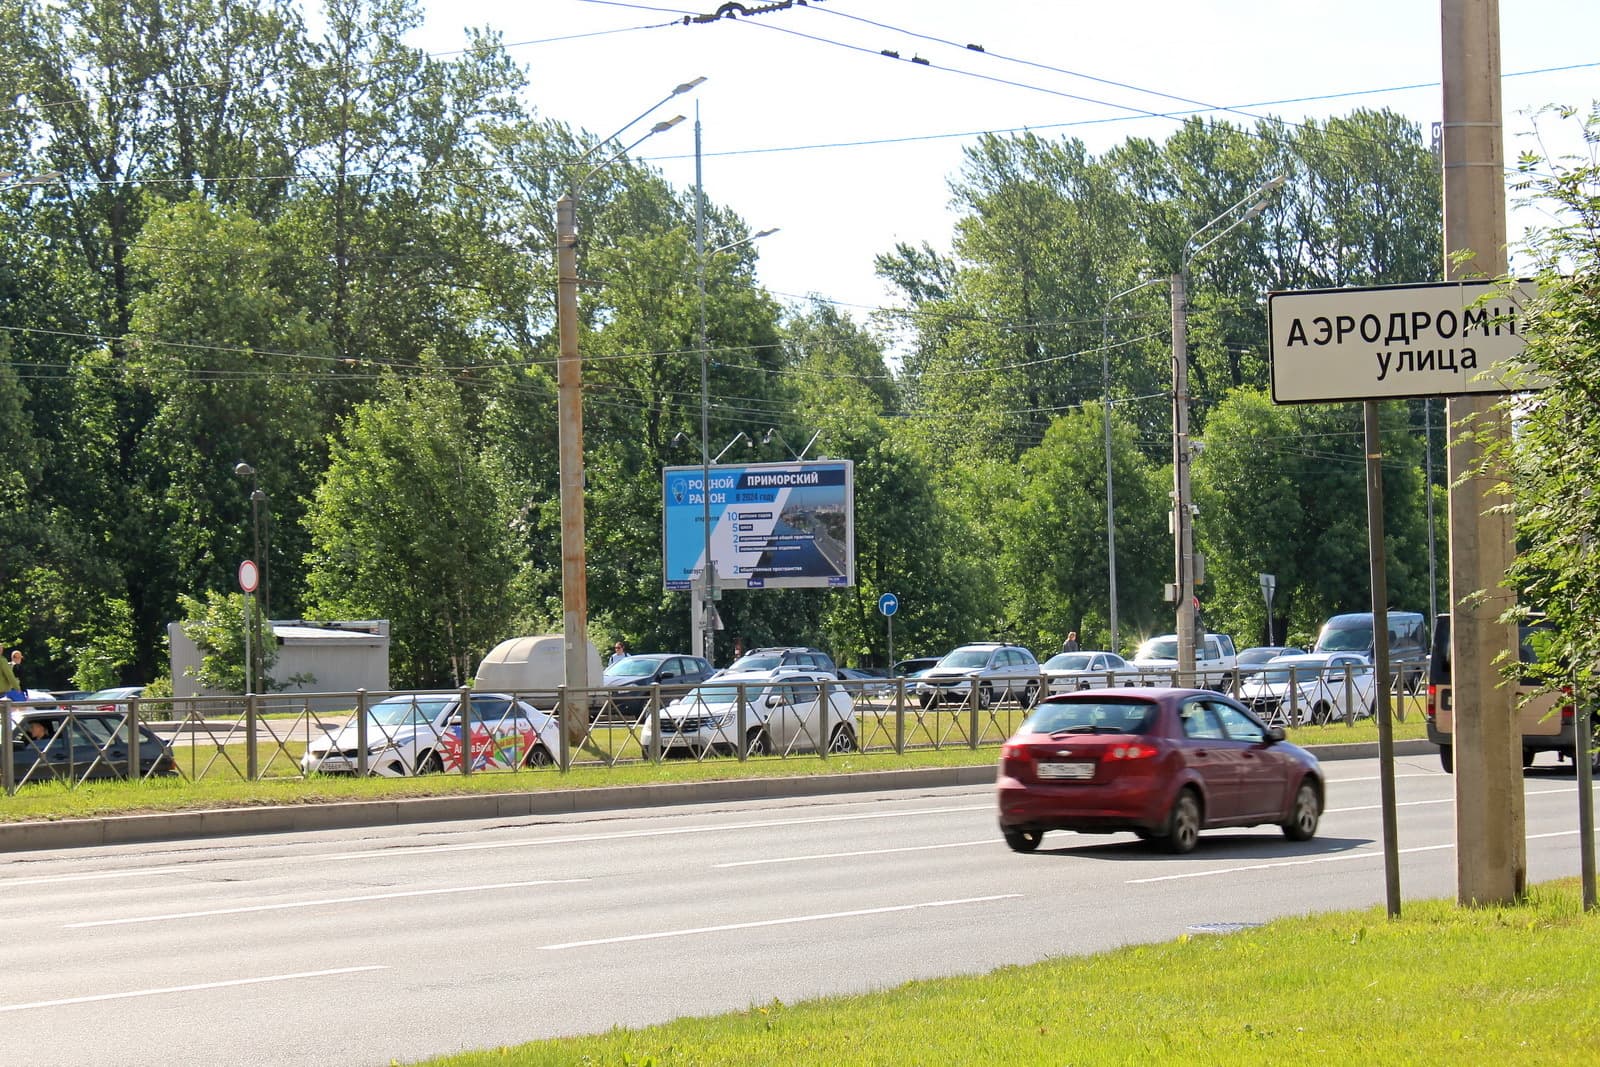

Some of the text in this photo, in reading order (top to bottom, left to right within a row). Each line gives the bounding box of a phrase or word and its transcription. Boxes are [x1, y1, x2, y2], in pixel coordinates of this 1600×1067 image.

[1287, 307, 1526, 347] АЭРОДРОМН
[1376, 347, 1477, 381] улица
[747, 471, 819, 487] ПРИМОРСКИЙ
[688, 493, 726, 504] РАОН
[727, 511, 738, 521] 10
[732, 523, 738, 532] 5
[733, 534, 739, 543] 2
[733, 565, 739, 574] 2
